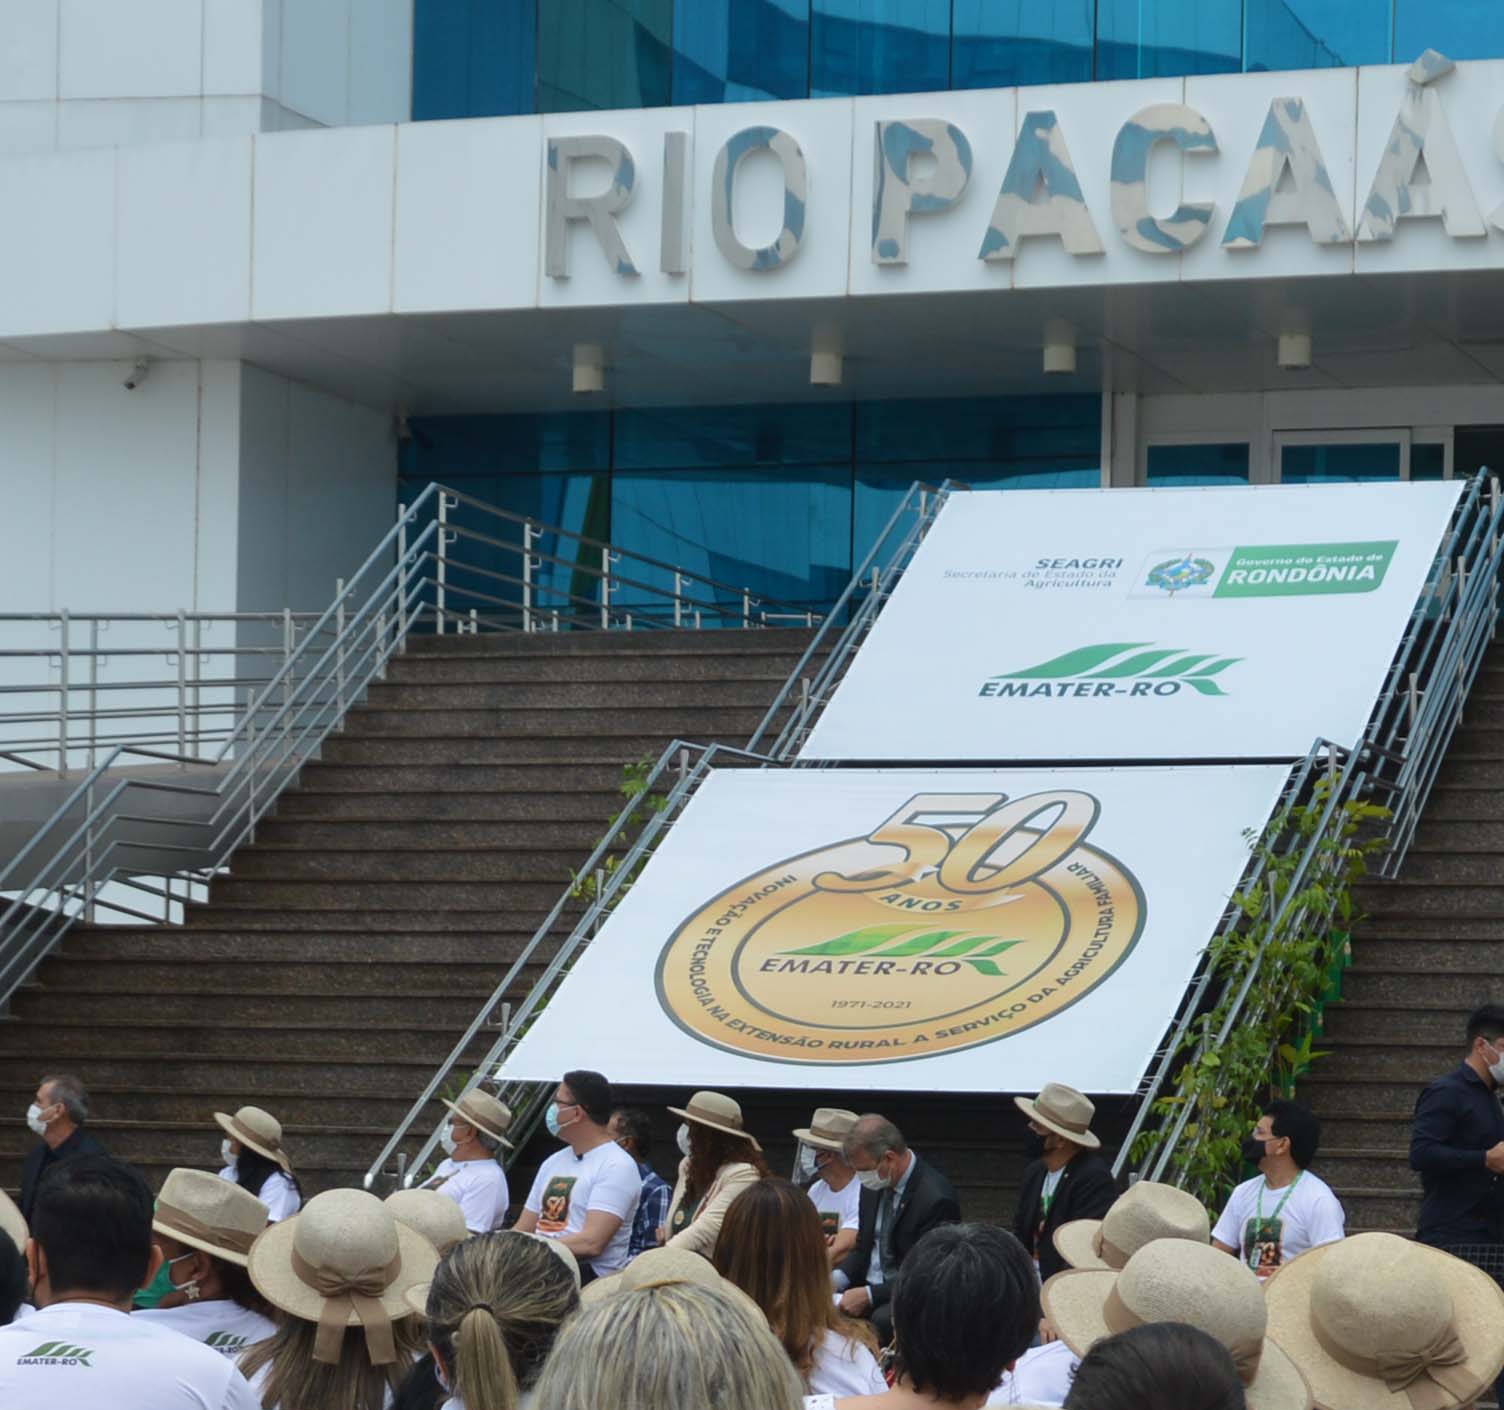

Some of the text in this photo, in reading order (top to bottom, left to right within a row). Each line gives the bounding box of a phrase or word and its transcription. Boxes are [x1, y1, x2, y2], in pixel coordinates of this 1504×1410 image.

[544, 123, 808, 282] RIO
[1035, 557, 1123, 569] SEAGRI
[1236, 552, 1383, 567] Governo do Estado de
[1024, 578, 1112, 589] Agricultura
[1227, 563, 1375, 585] RONDÔNIA
[978, 679, 1182, 698] EMATER-RO
[812, 788, 1102, 894] 50
[879, 892, 963, 912] ANOS
[689, 861, 1116, 1050] INOVAÇÃO E TECNOLOGIA NA EXTENSÃO RURAL A SERVIÇO DA AGRICULTURA FAMILIAR
[759, 957, 962, 976] EMATER-RO
[831, 999, 912, 1009] 1971-2021
